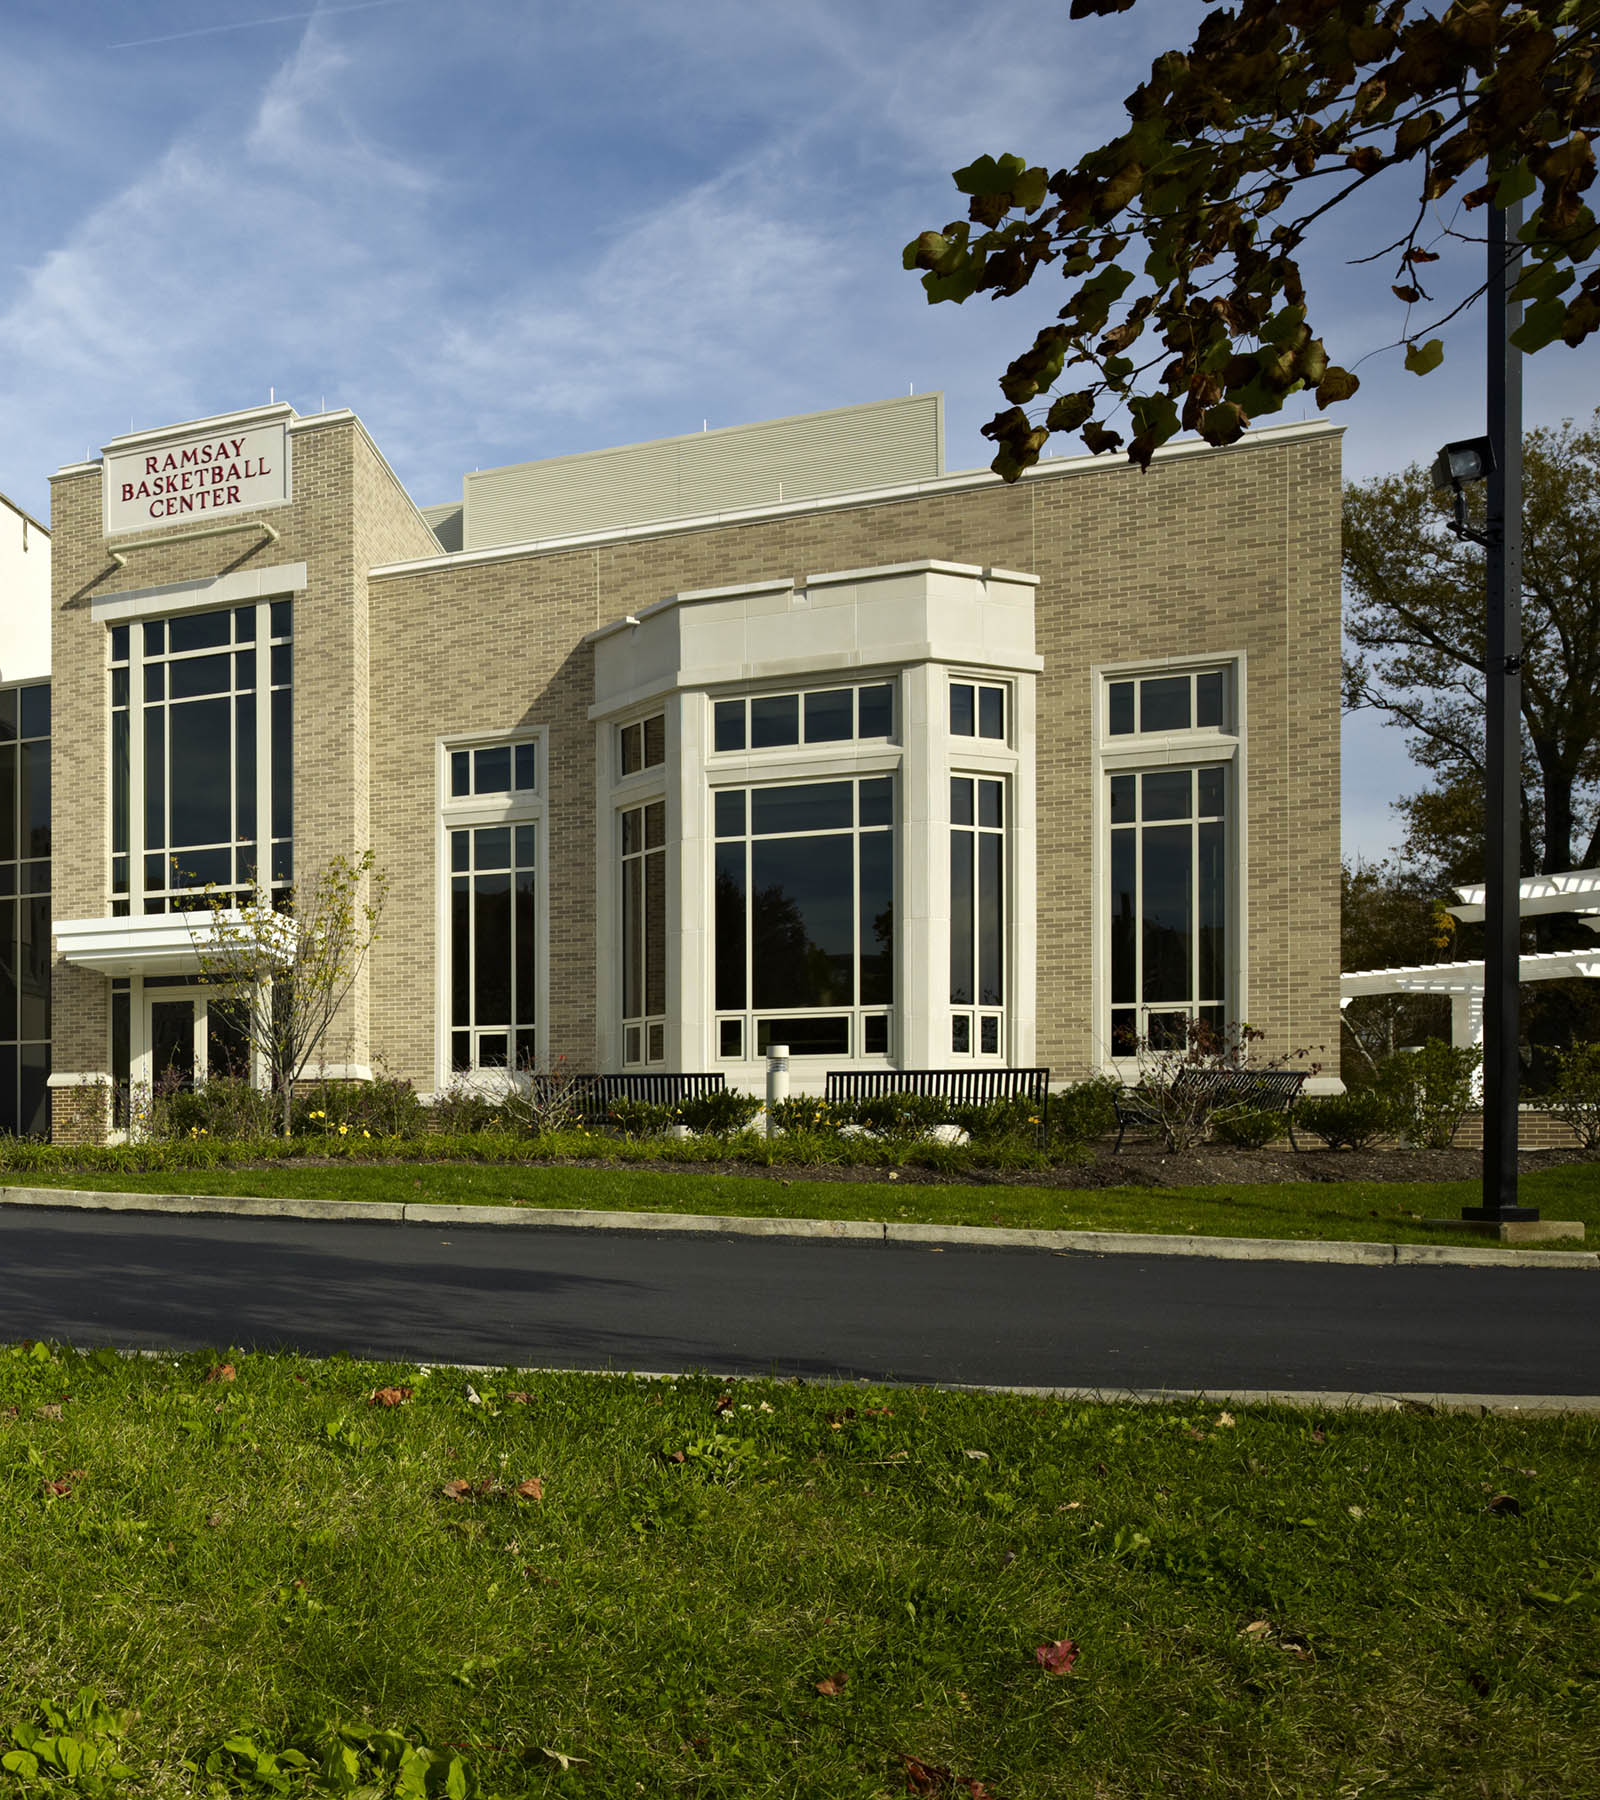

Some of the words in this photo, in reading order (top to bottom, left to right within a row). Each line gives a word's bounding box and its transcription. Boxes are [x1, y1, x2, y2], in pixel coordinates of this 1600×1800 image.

[145, 437, 246, 475] RAMSAY
[121, 457, 272, 502] BASKETBALL
[149, 485, 242, 519] CENTER
